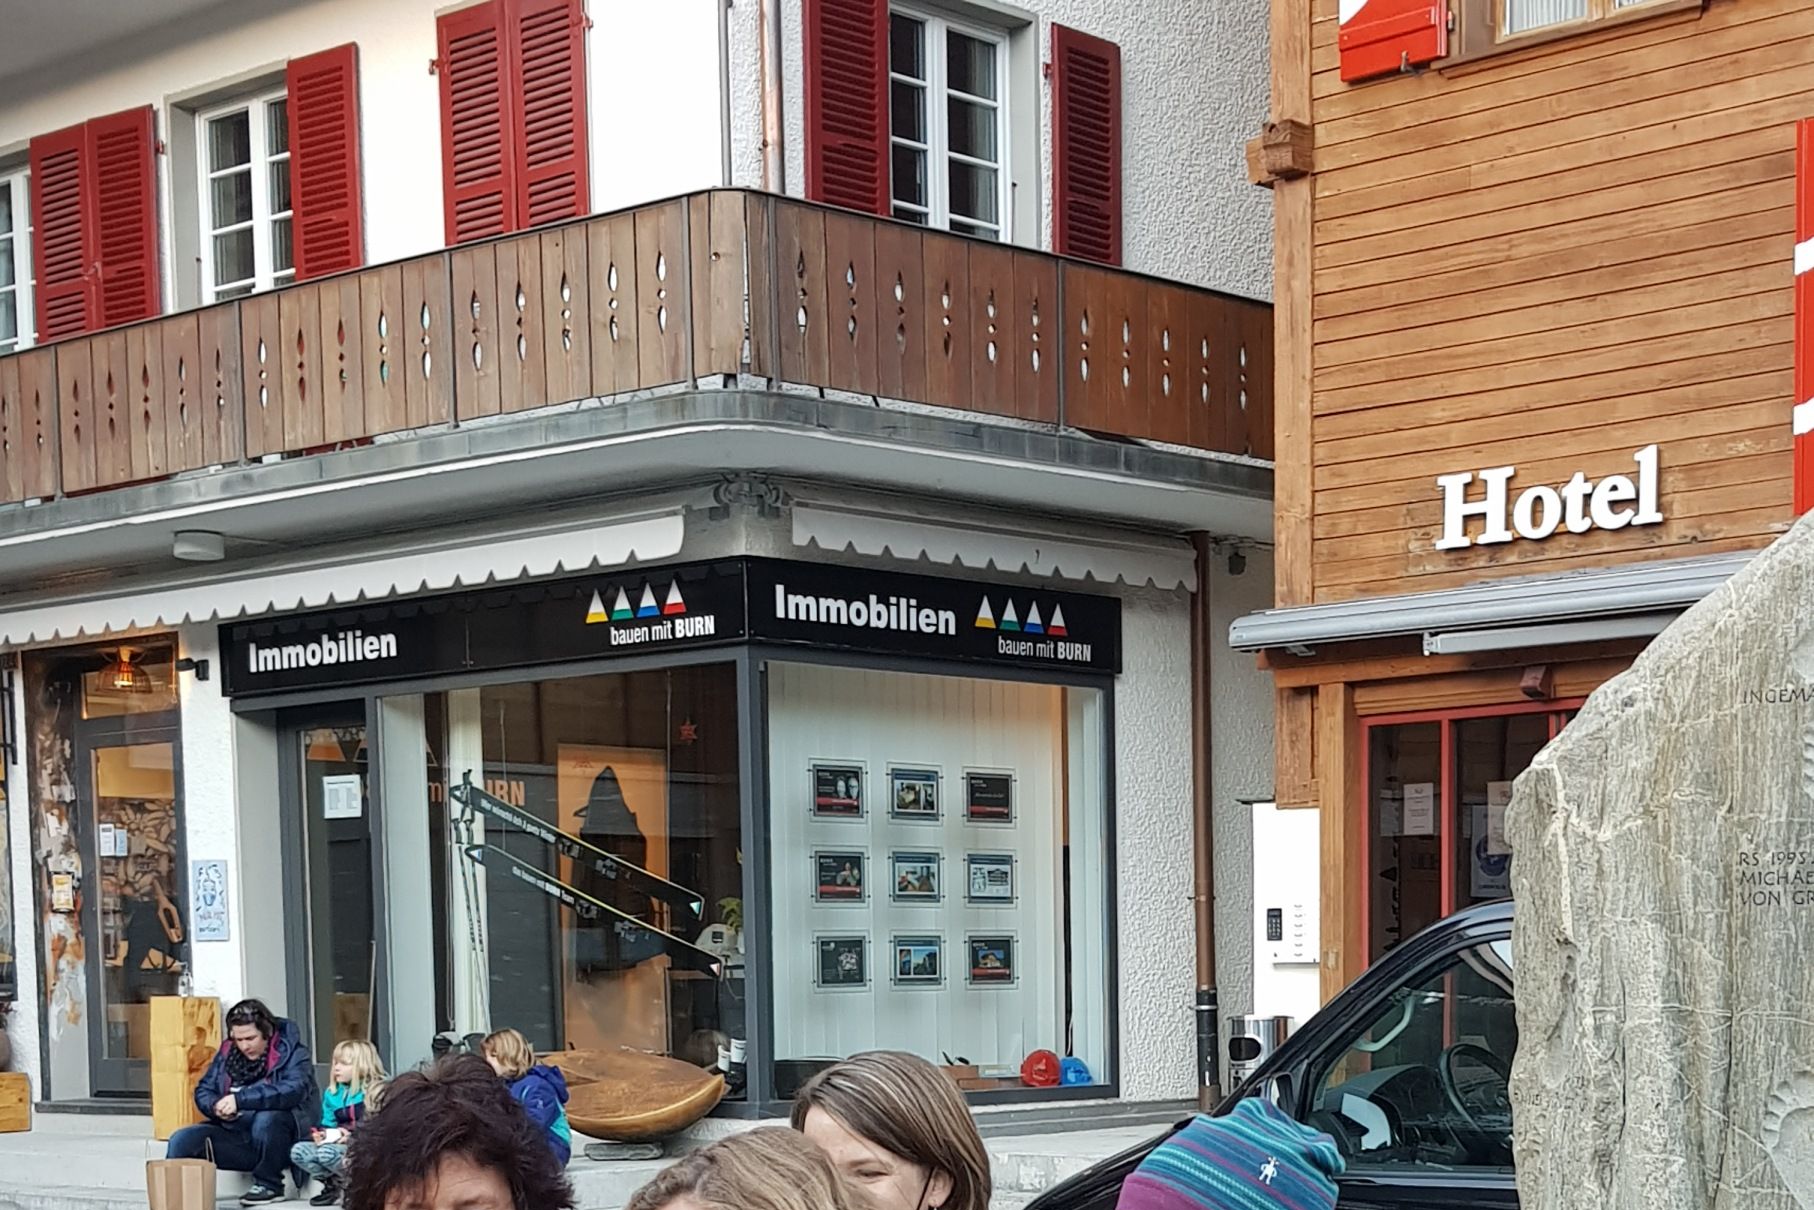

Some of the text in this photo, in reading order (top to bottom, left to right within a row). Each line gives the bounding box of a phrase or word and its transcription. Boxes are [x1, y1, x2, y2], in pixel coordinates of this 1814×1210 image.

[1434, 443, 1664, 551] Hotel
[767, 583, 956, 636] Immobilien
[610, 614, 716, 646] bauen mit BURN
[249, 629, 398, 673] Immobilien
[998, 635, 1092, 663] bauen mit BURN
[1739, 851, 1760, 867] RS
[1739, 890, 1782, 907] VON
